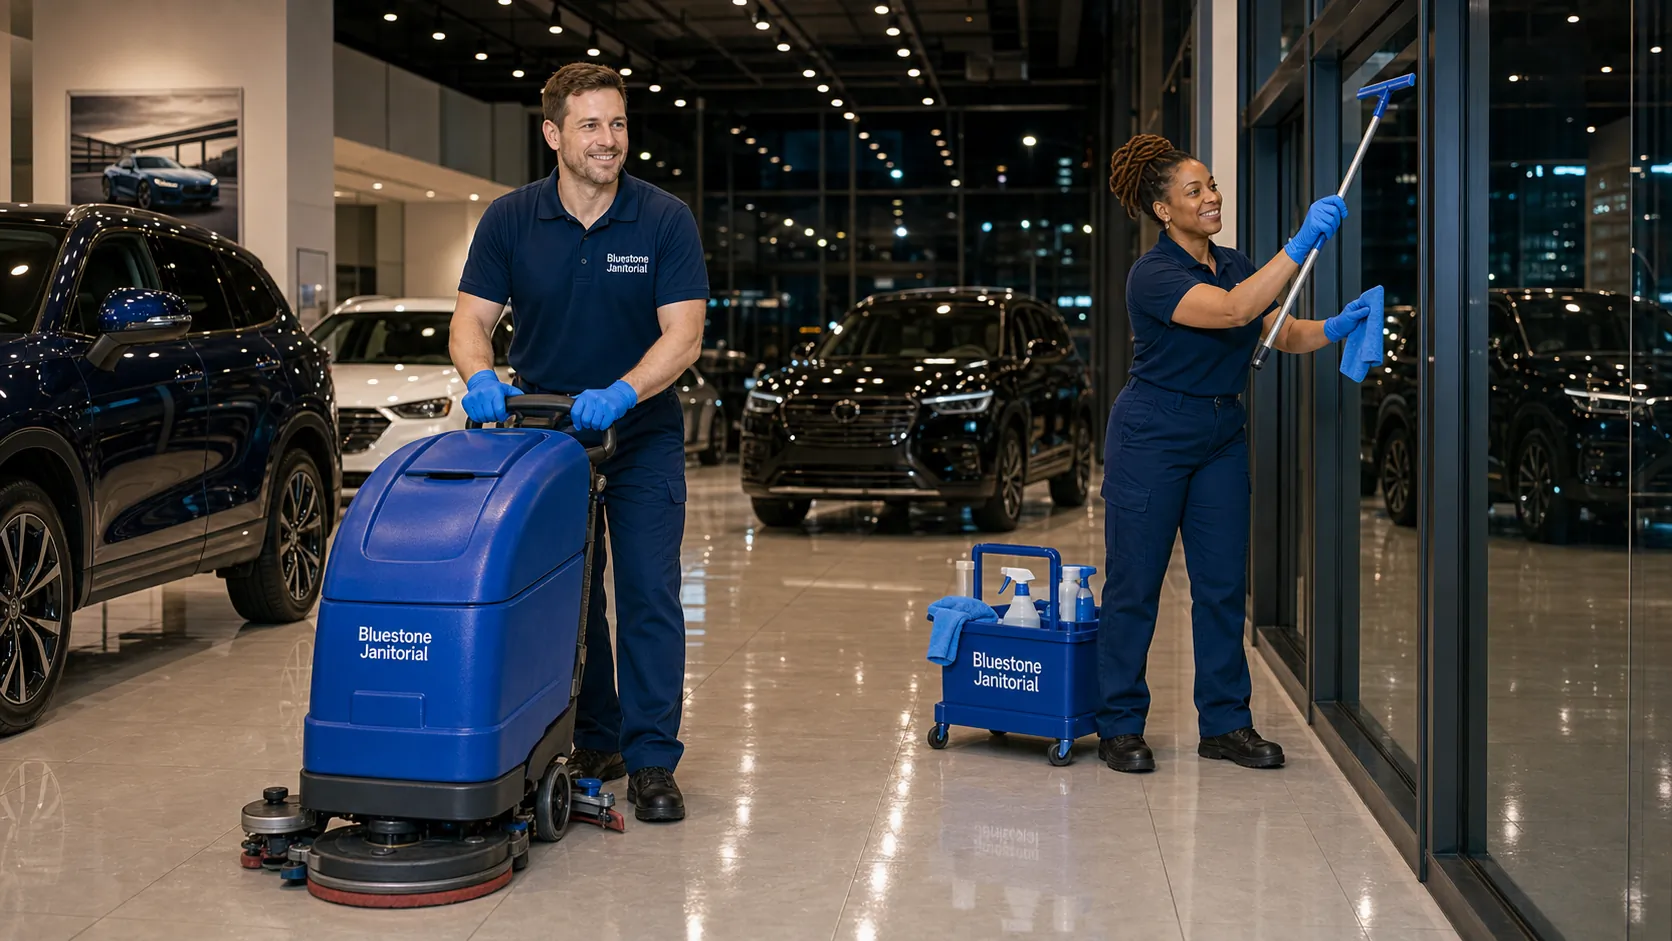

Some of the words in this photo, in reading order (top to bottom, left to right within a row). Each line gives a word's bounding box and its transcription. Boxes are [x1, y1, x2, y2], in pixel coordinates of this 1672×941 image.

[358, 626, 432, 644] Bluestone
[360, 644, 428, 661] Janitorial
[973, 651, 1042, 674] Bluestone
[973, 670, 1039, 693] Janitorial
